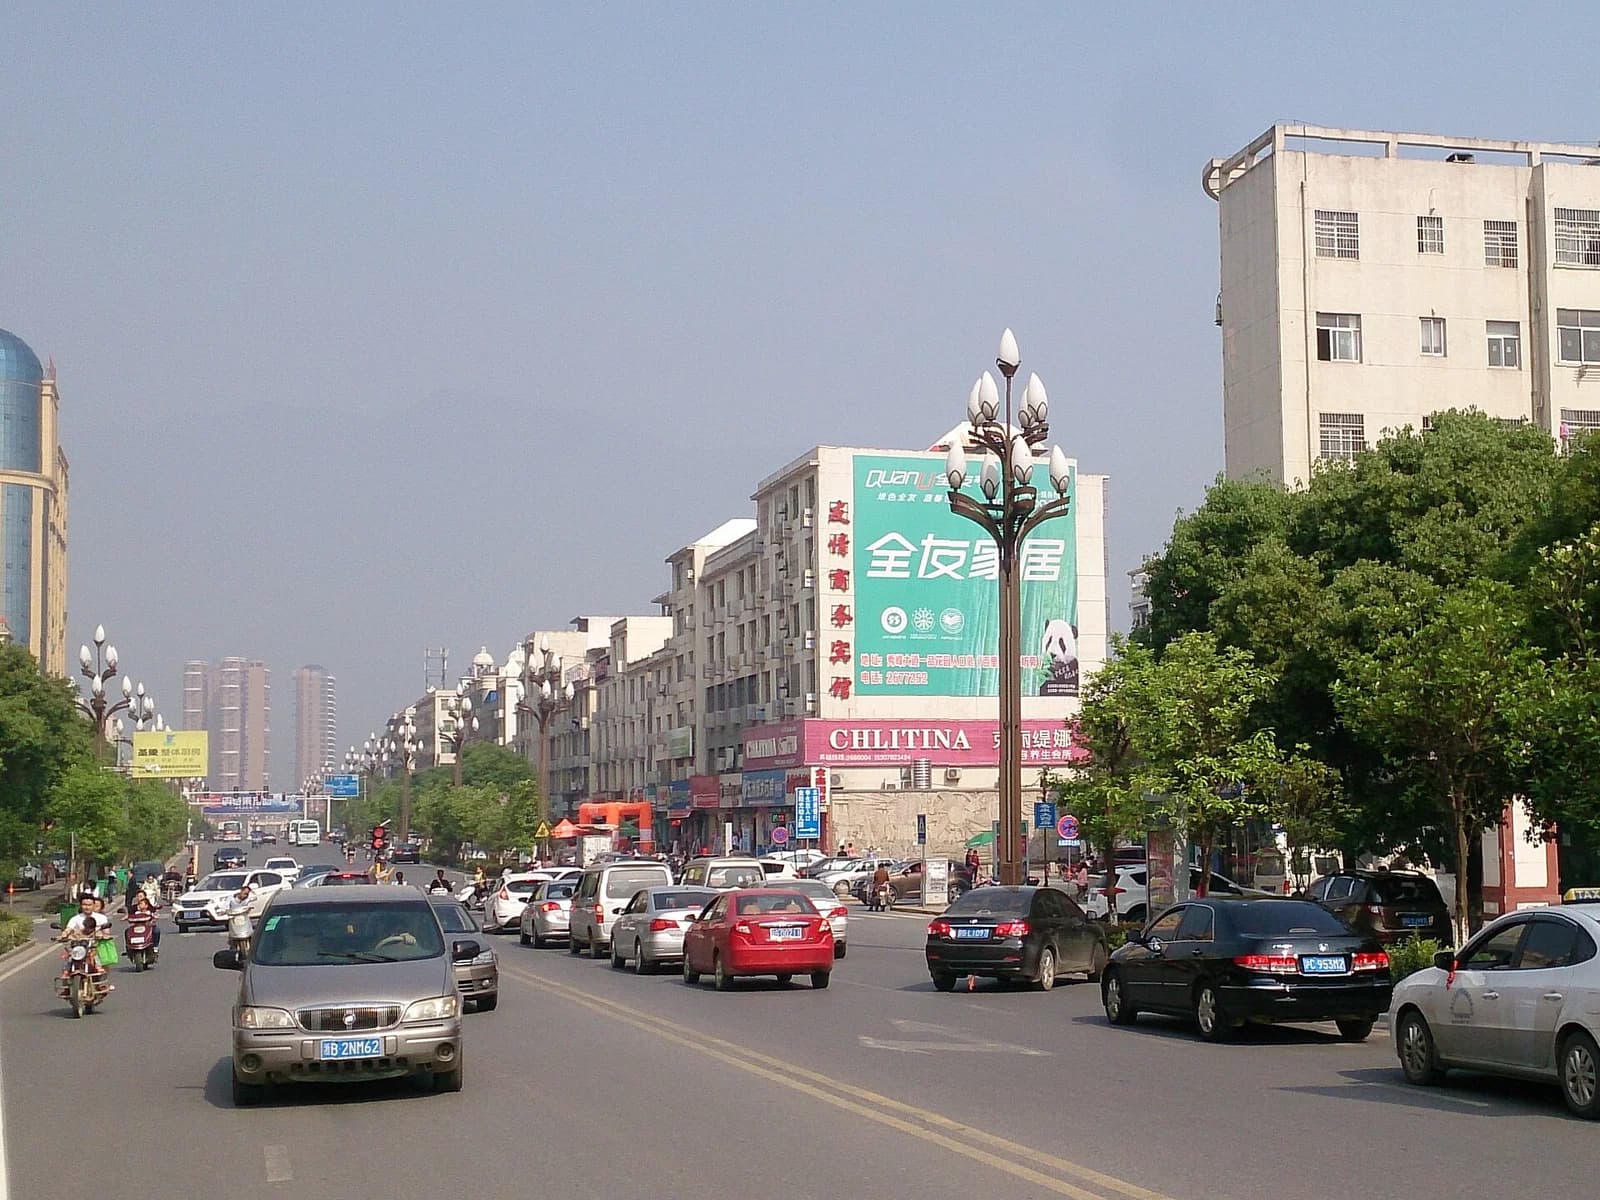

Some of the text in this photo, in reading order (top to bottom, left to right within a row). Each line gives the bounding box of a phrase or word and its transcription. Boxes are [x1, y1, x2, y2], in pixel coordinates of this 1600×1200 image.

[865, 531, 1066, 582] 全友家居
[829, 728, 971, 751] CHLITINA
